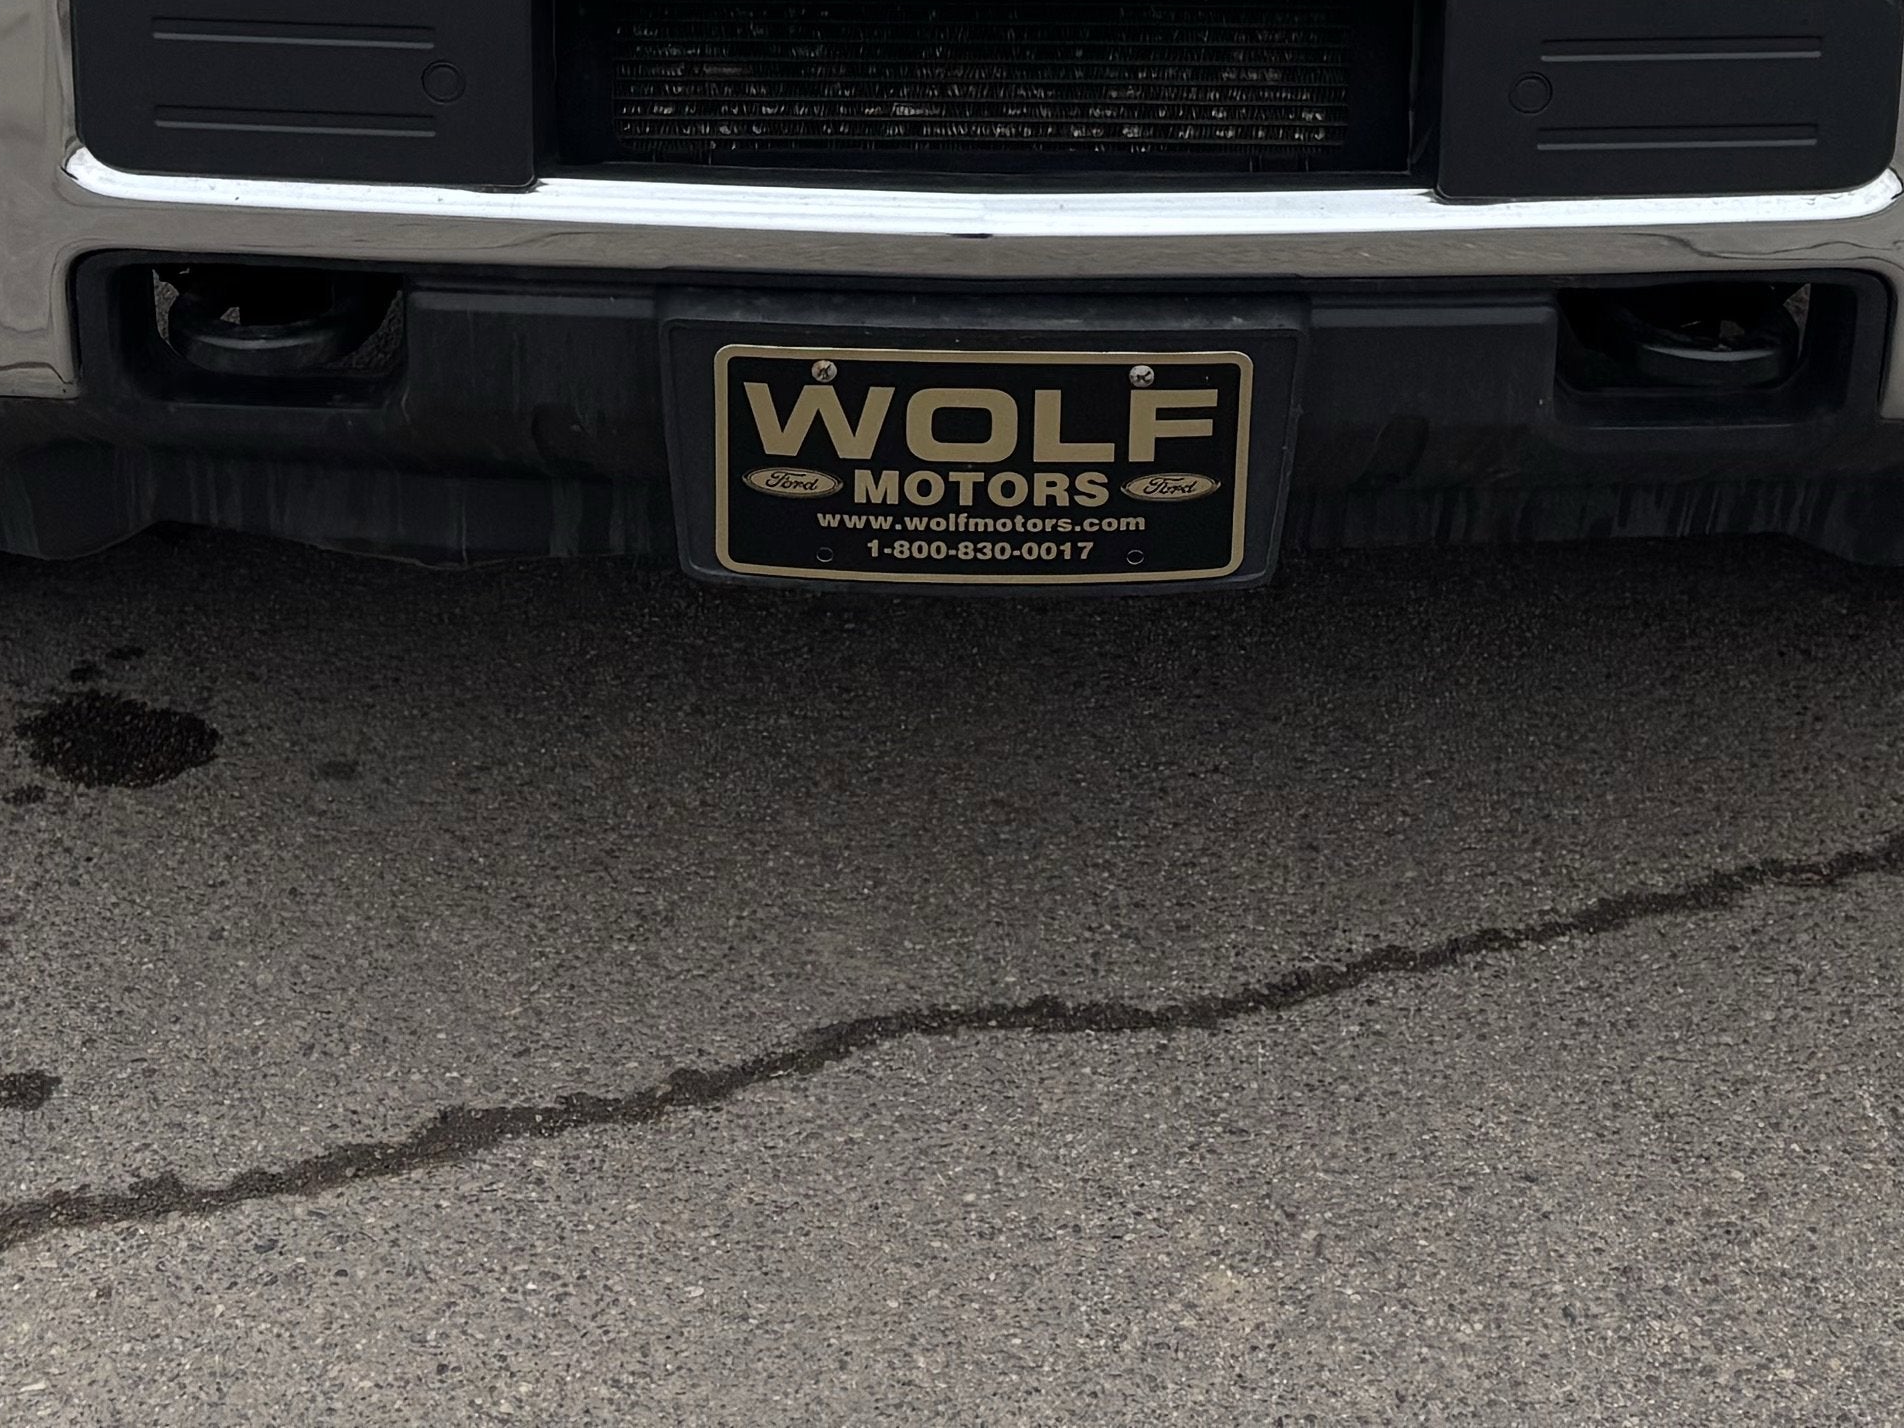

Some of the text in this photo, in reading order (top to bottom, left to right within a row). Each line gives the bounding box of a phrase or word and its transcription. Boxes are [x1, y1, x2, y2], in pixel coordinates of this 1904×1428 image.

[743, 381, 1218, 463] WOLF
[764, 471, 820, 491] Ford
[854, 469, 1110, 507] MOTORS
[1143, 477, 1198, 495] Ford
[817, 512, 1146, 533] www.wolfmotors.com
[867, 539, 1094, 561] 1-800-830-0017
